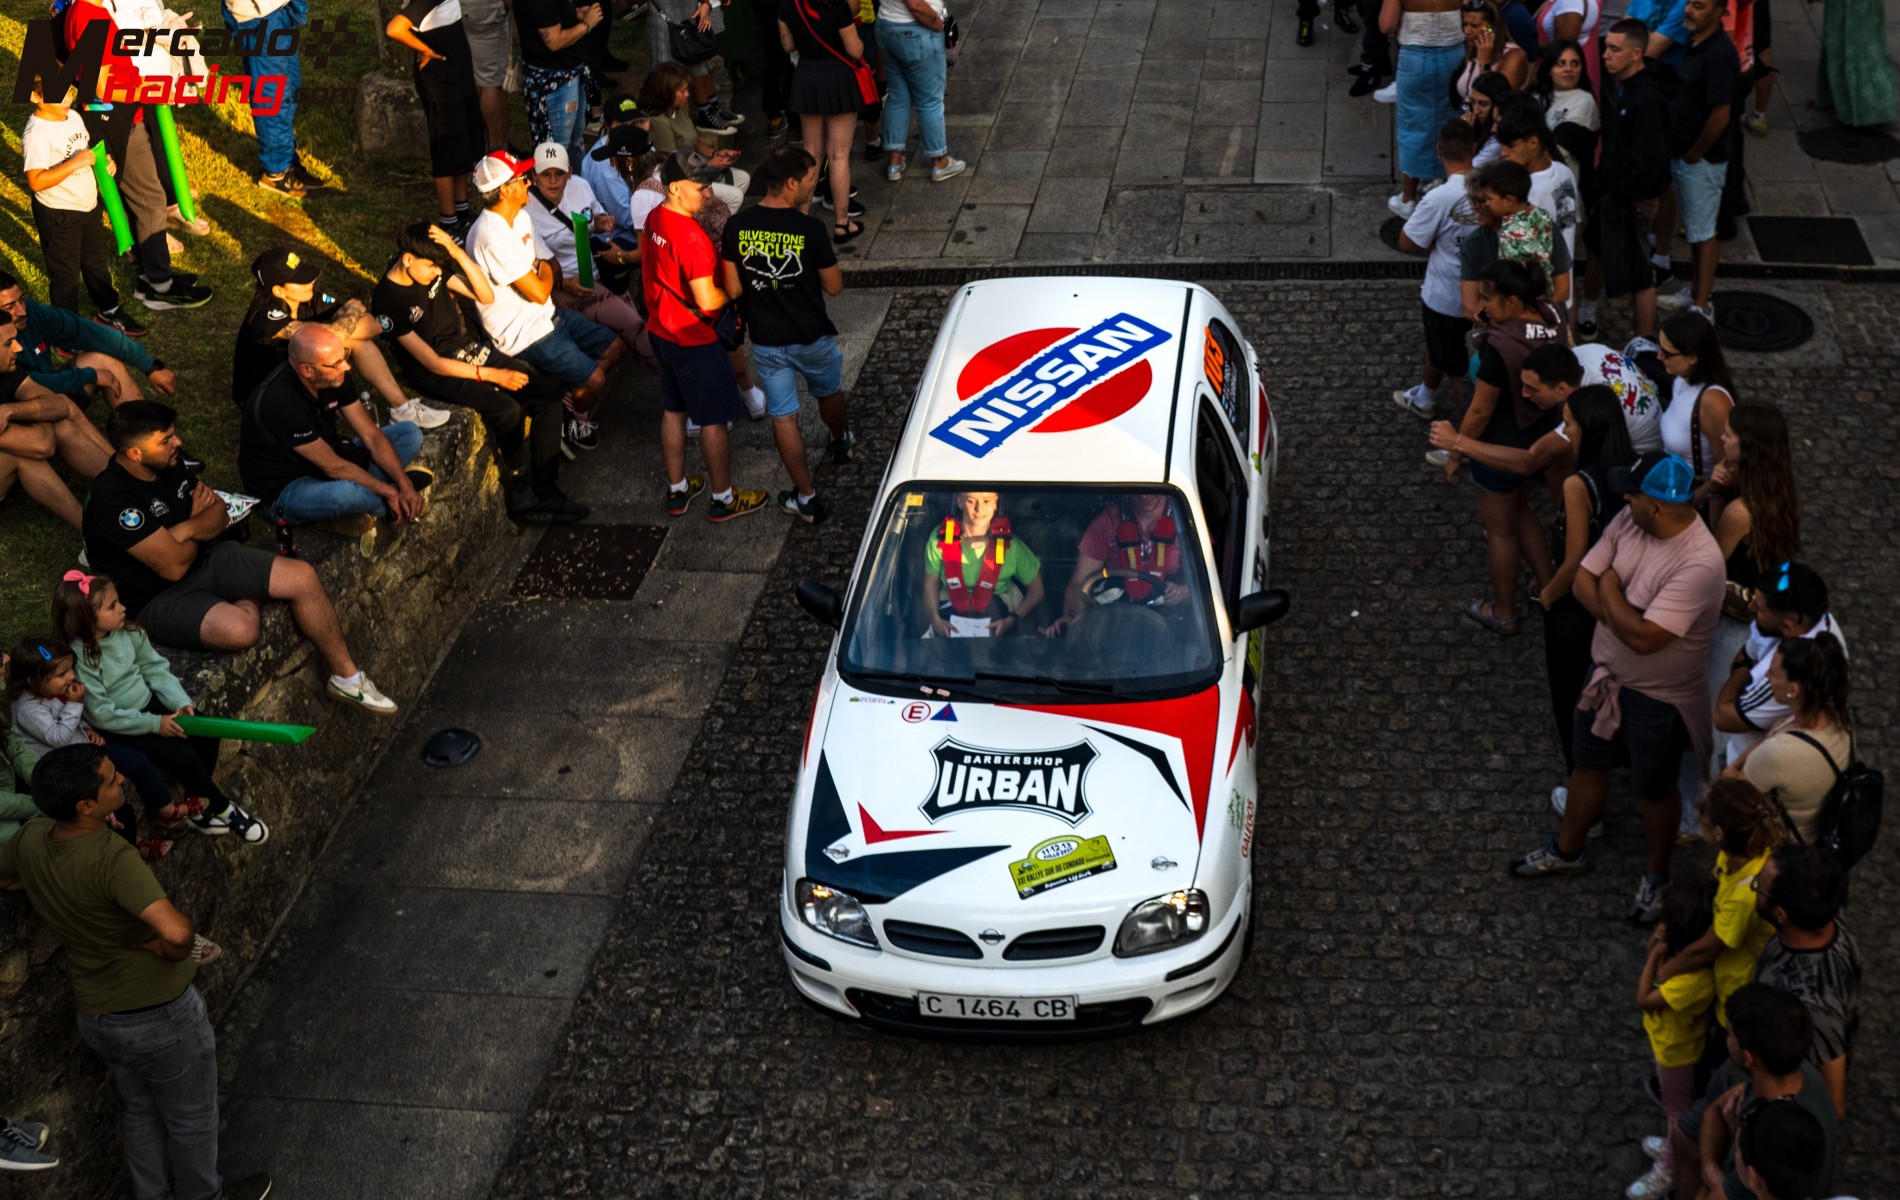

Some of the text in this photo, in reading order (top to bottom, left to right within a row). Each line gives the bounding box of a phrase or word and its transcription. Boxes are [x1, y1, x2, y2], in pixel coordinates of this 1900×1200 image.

[738, 230, 805, 245] SILVERSTONE
[738, 240, 805, 260] CIRCUIT
[948, 320, 1154, 446] NISSAN
[907, 705, 925, 719] E
[963, 754, 1063, 766] BARBERSHOP
[937, 760, 1081, 813] URBAN
[926, 995, 1068, 1018] C 1464 CB
